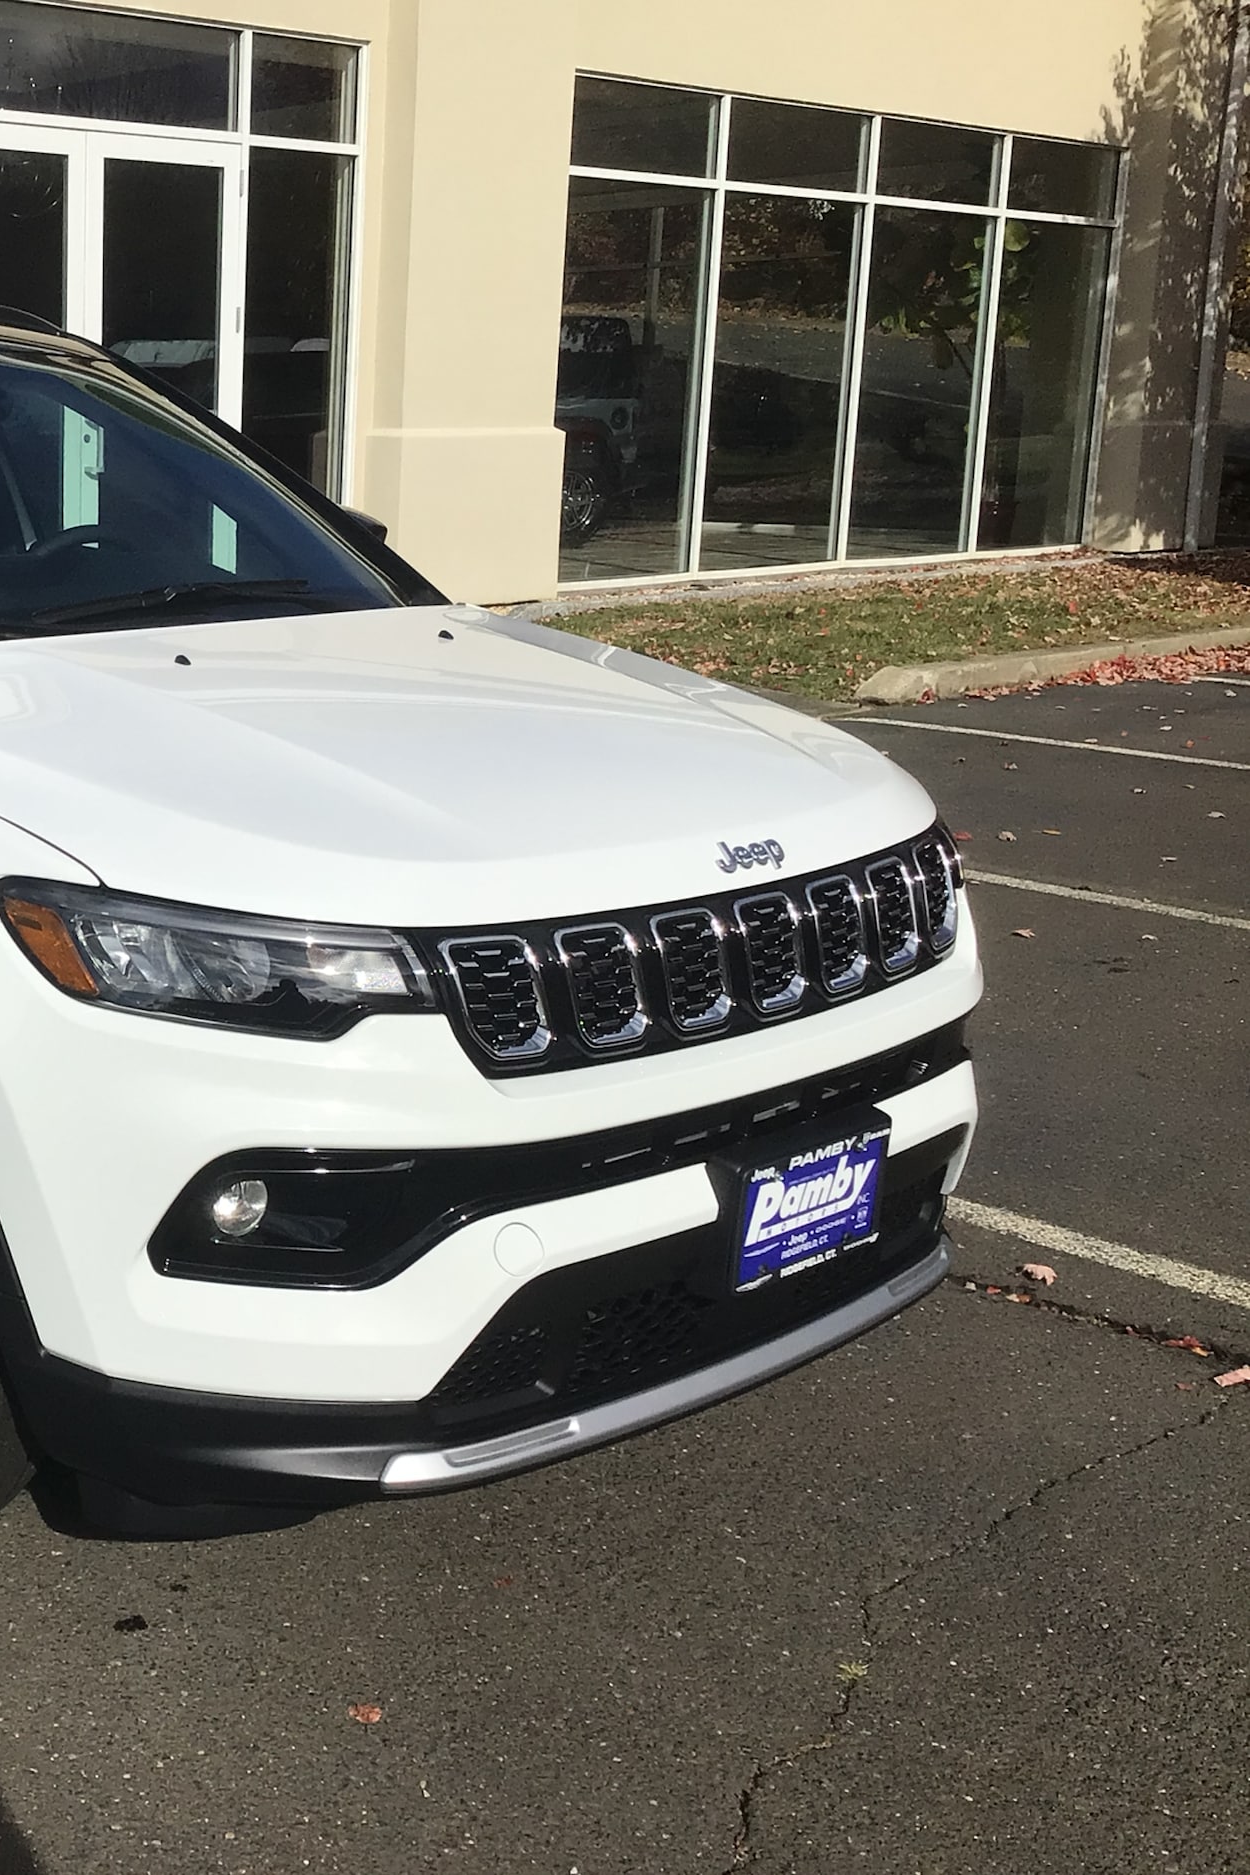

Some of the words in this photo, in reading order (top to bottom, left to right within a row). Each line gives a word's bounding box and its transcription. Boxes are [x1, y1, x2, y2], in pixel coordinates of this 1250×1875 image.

[715, 839, 785, 873] Jeep
[788, 1136, 858, 1171] PAMBY
[743, 1155, 877, 1247] Pamby
